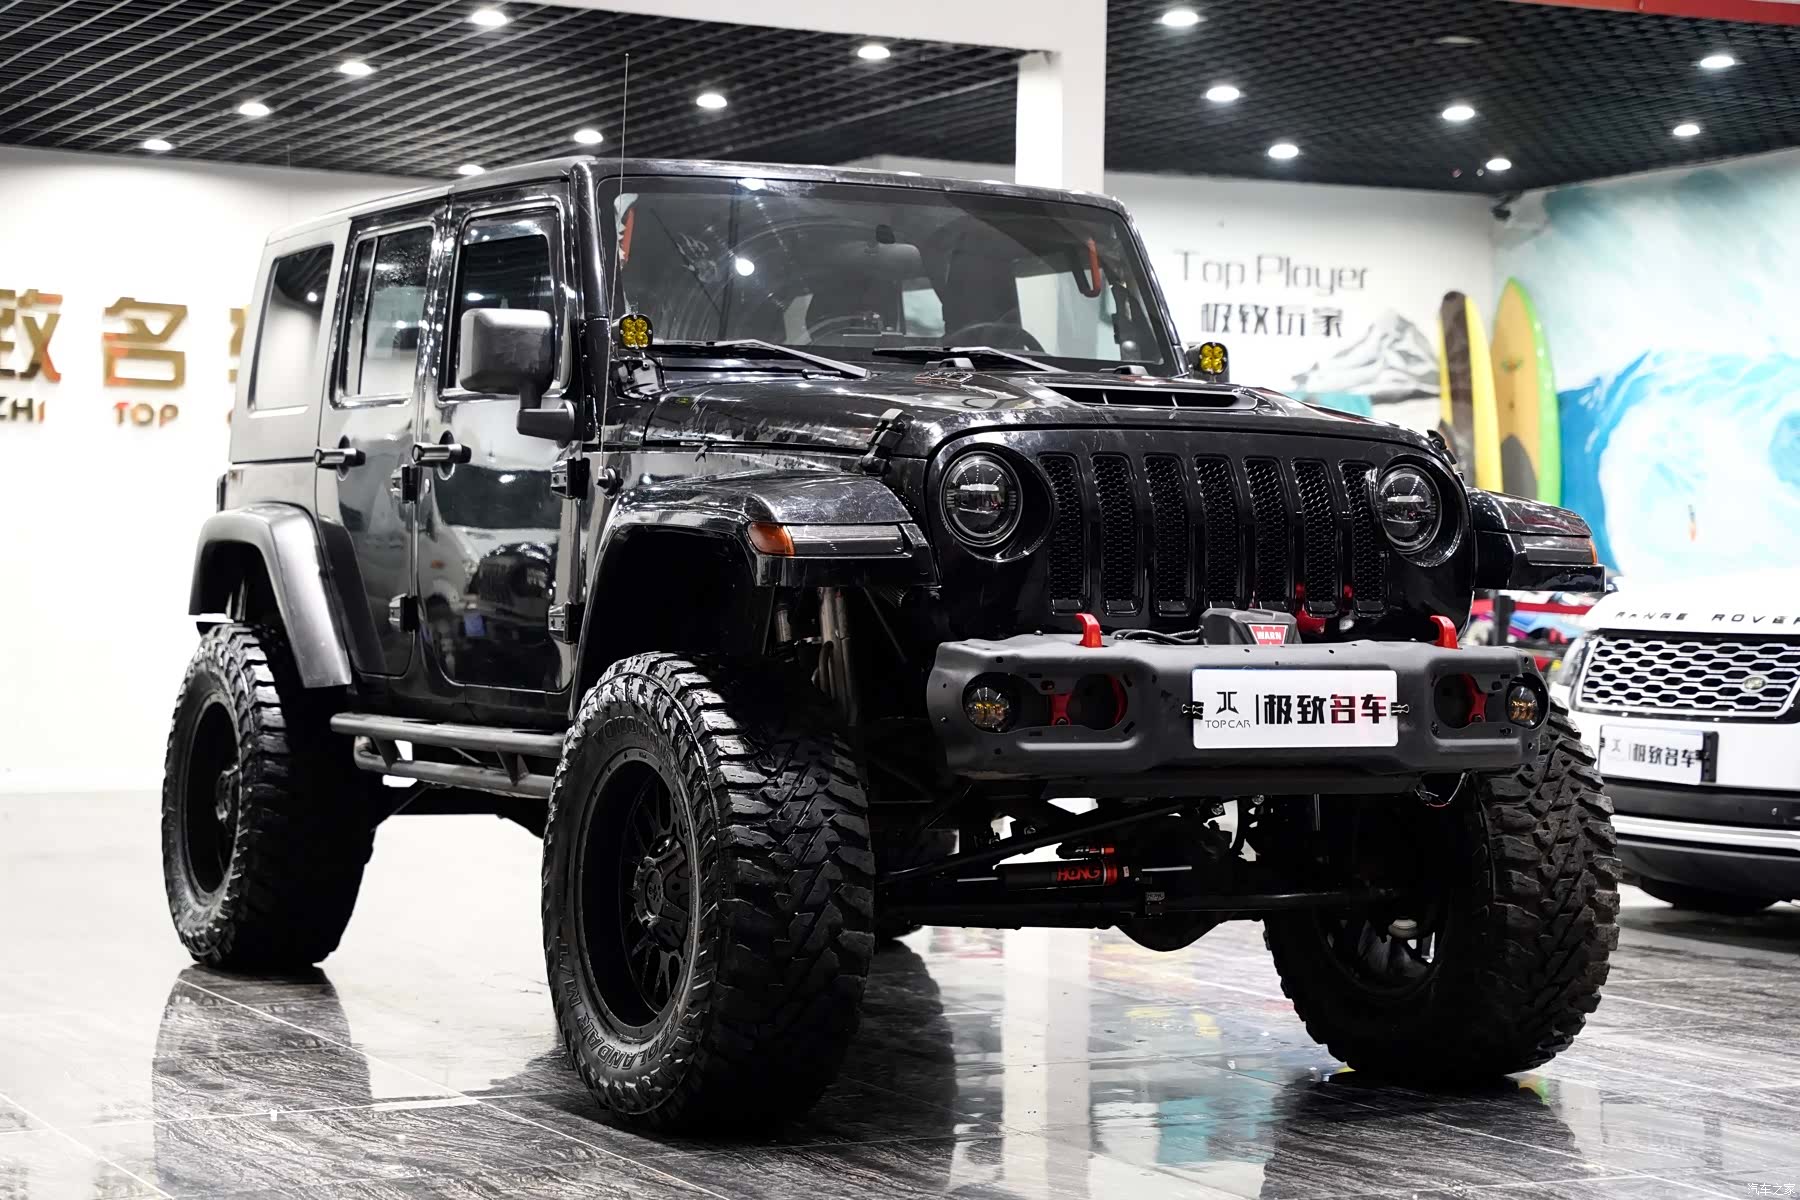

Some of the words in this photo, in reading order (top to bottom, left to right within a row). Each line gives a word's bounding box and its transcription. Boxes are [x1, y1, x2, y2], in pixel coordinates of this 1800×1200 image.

[1174, 249, 1246, 290] Top
[1256, 253, 1370, 296] Player
[114, 402, 179, 428] TOP
[1614, 611, 1688, 621] RANGE
[1256, 631, 1282, 640] WARN
[1264, 693, 1387, 725] 极致名车
